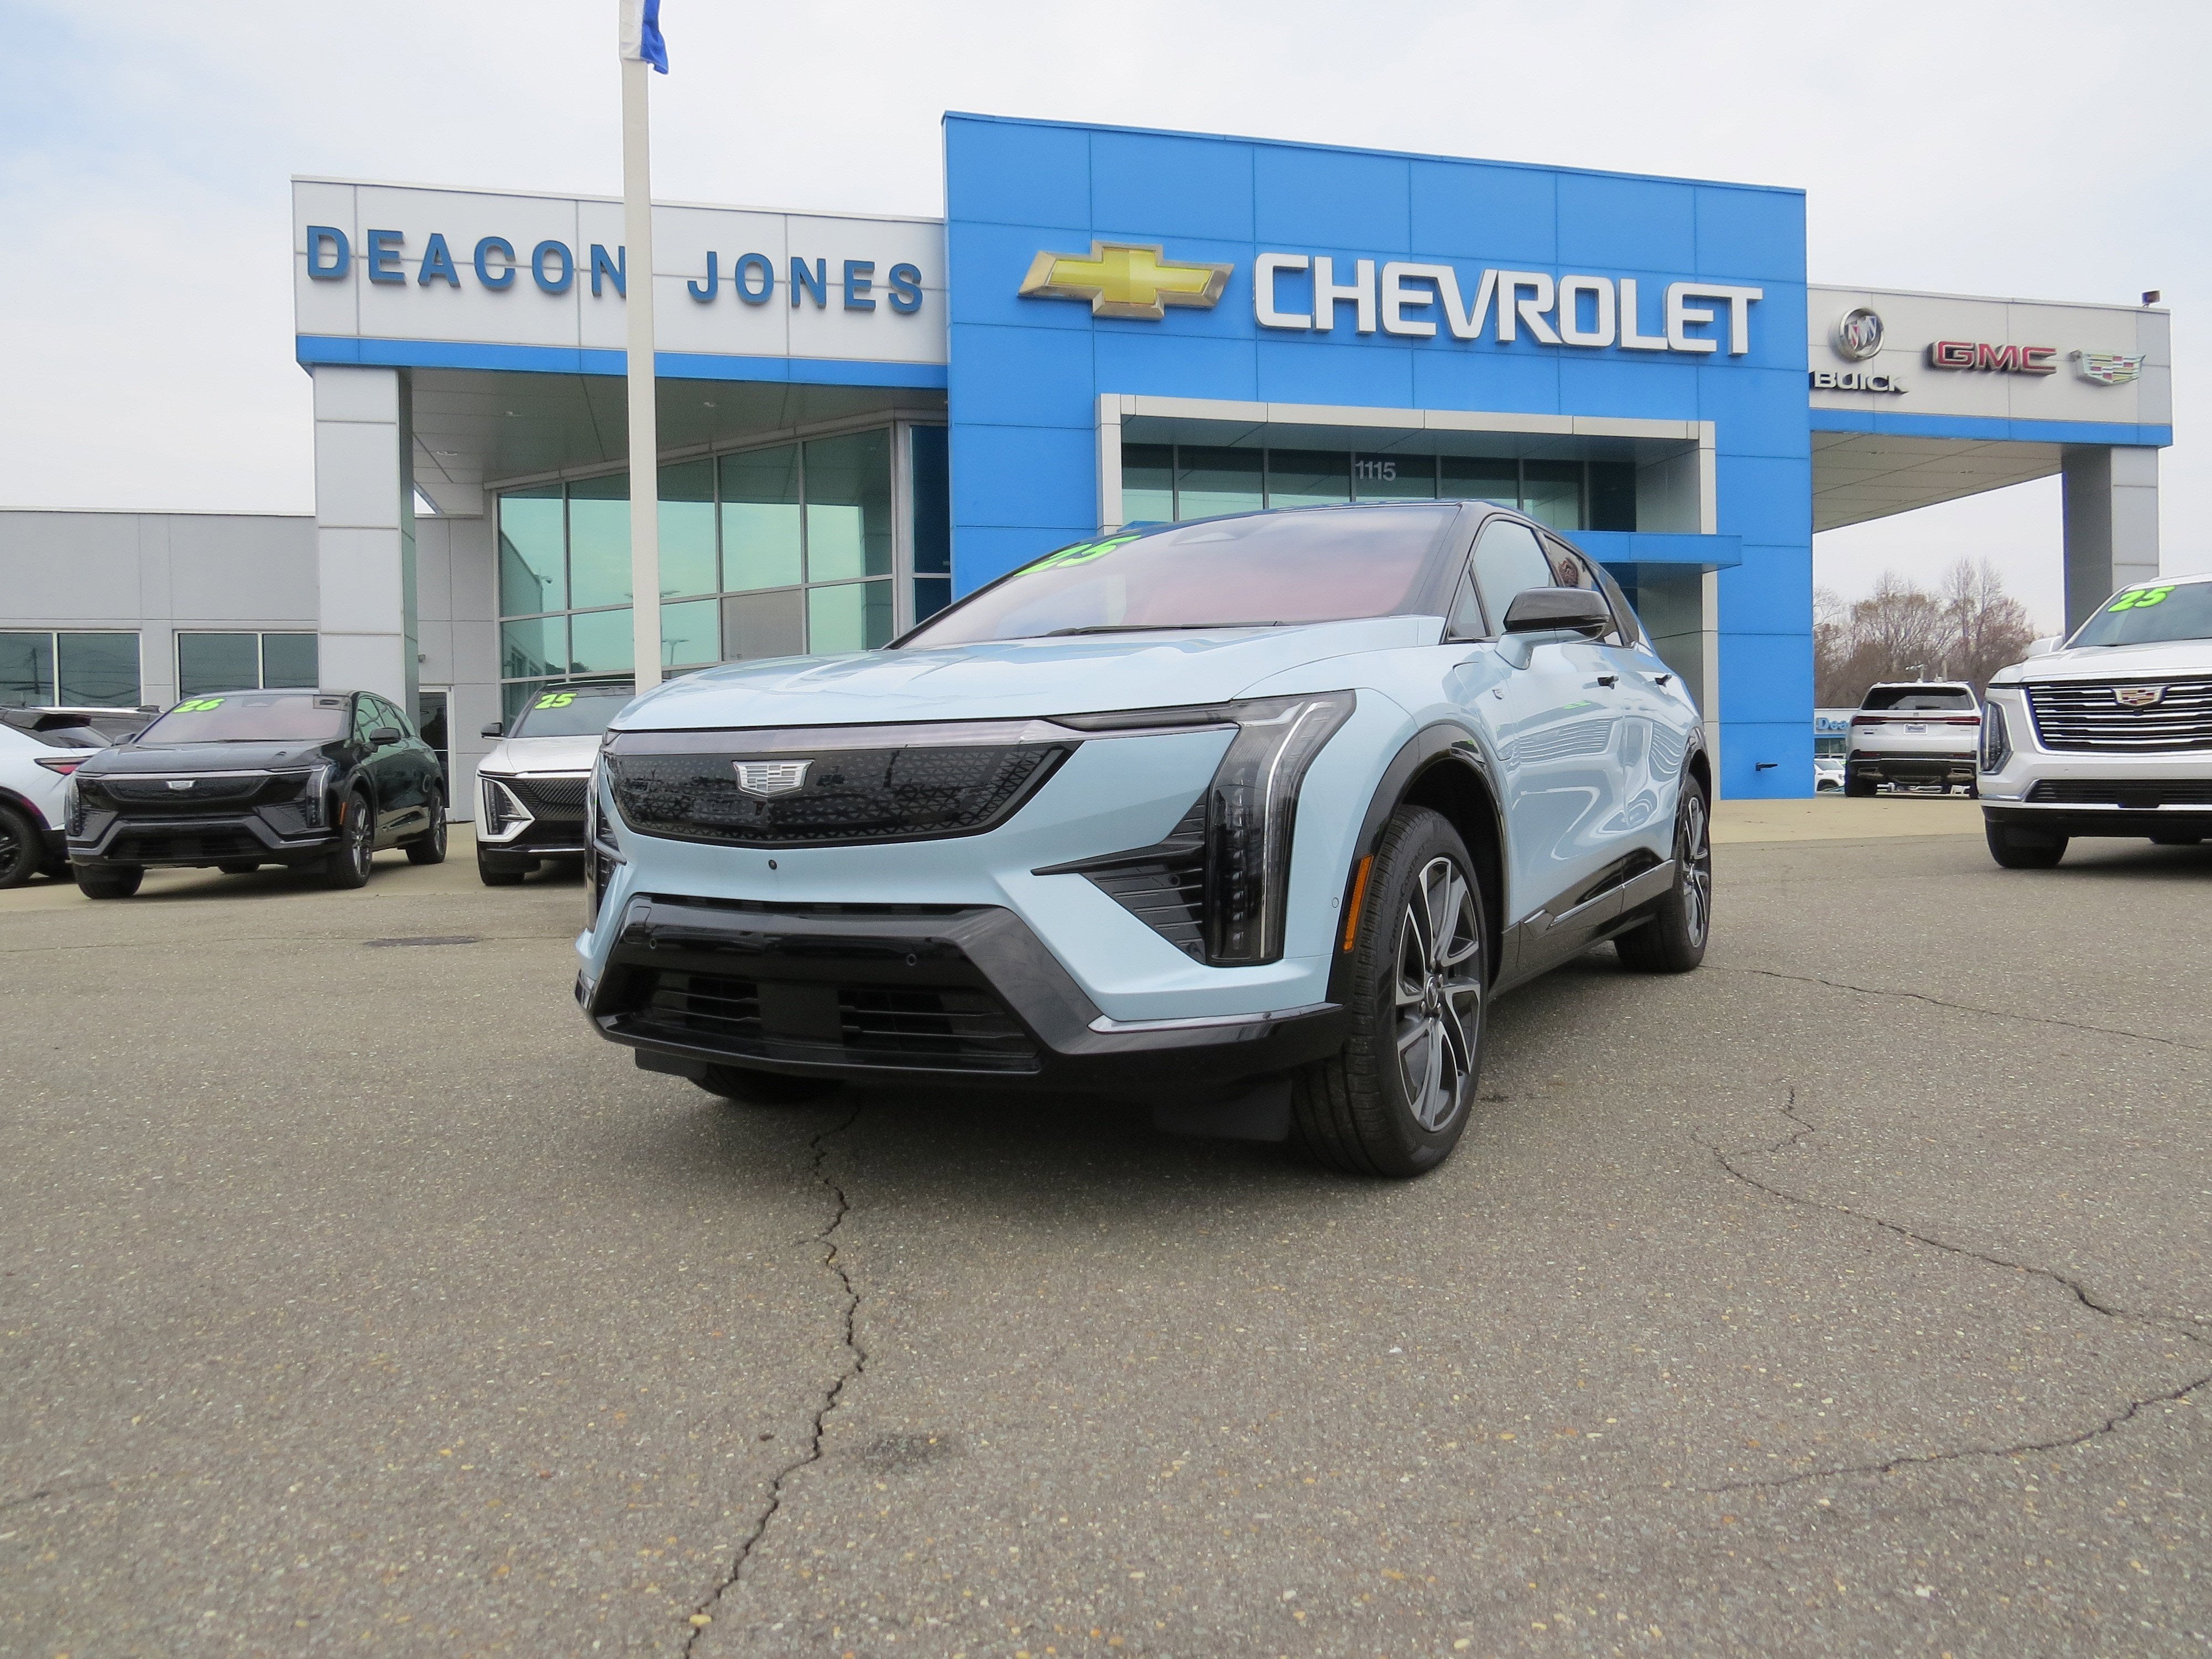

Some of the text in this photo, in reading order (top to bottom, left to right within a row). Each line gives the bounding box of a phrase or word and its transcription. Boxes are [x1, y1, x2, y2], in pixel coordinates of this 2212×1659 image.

[306, 225, 924, 314] DEACON JONES
[1252, 252, 1763, 356] CHEVROLET
[1932, 339, 2057, 377] GMC
[1811, 371, 1908, 394] BUICK
[1355, 460, 1397, 482] 1115
[1013, 534, 1142, 577] 25
[2107, 585, 2177, 613] 25
[173, 697, 226, 714] 26
[533, 692, 578, 709] 25
